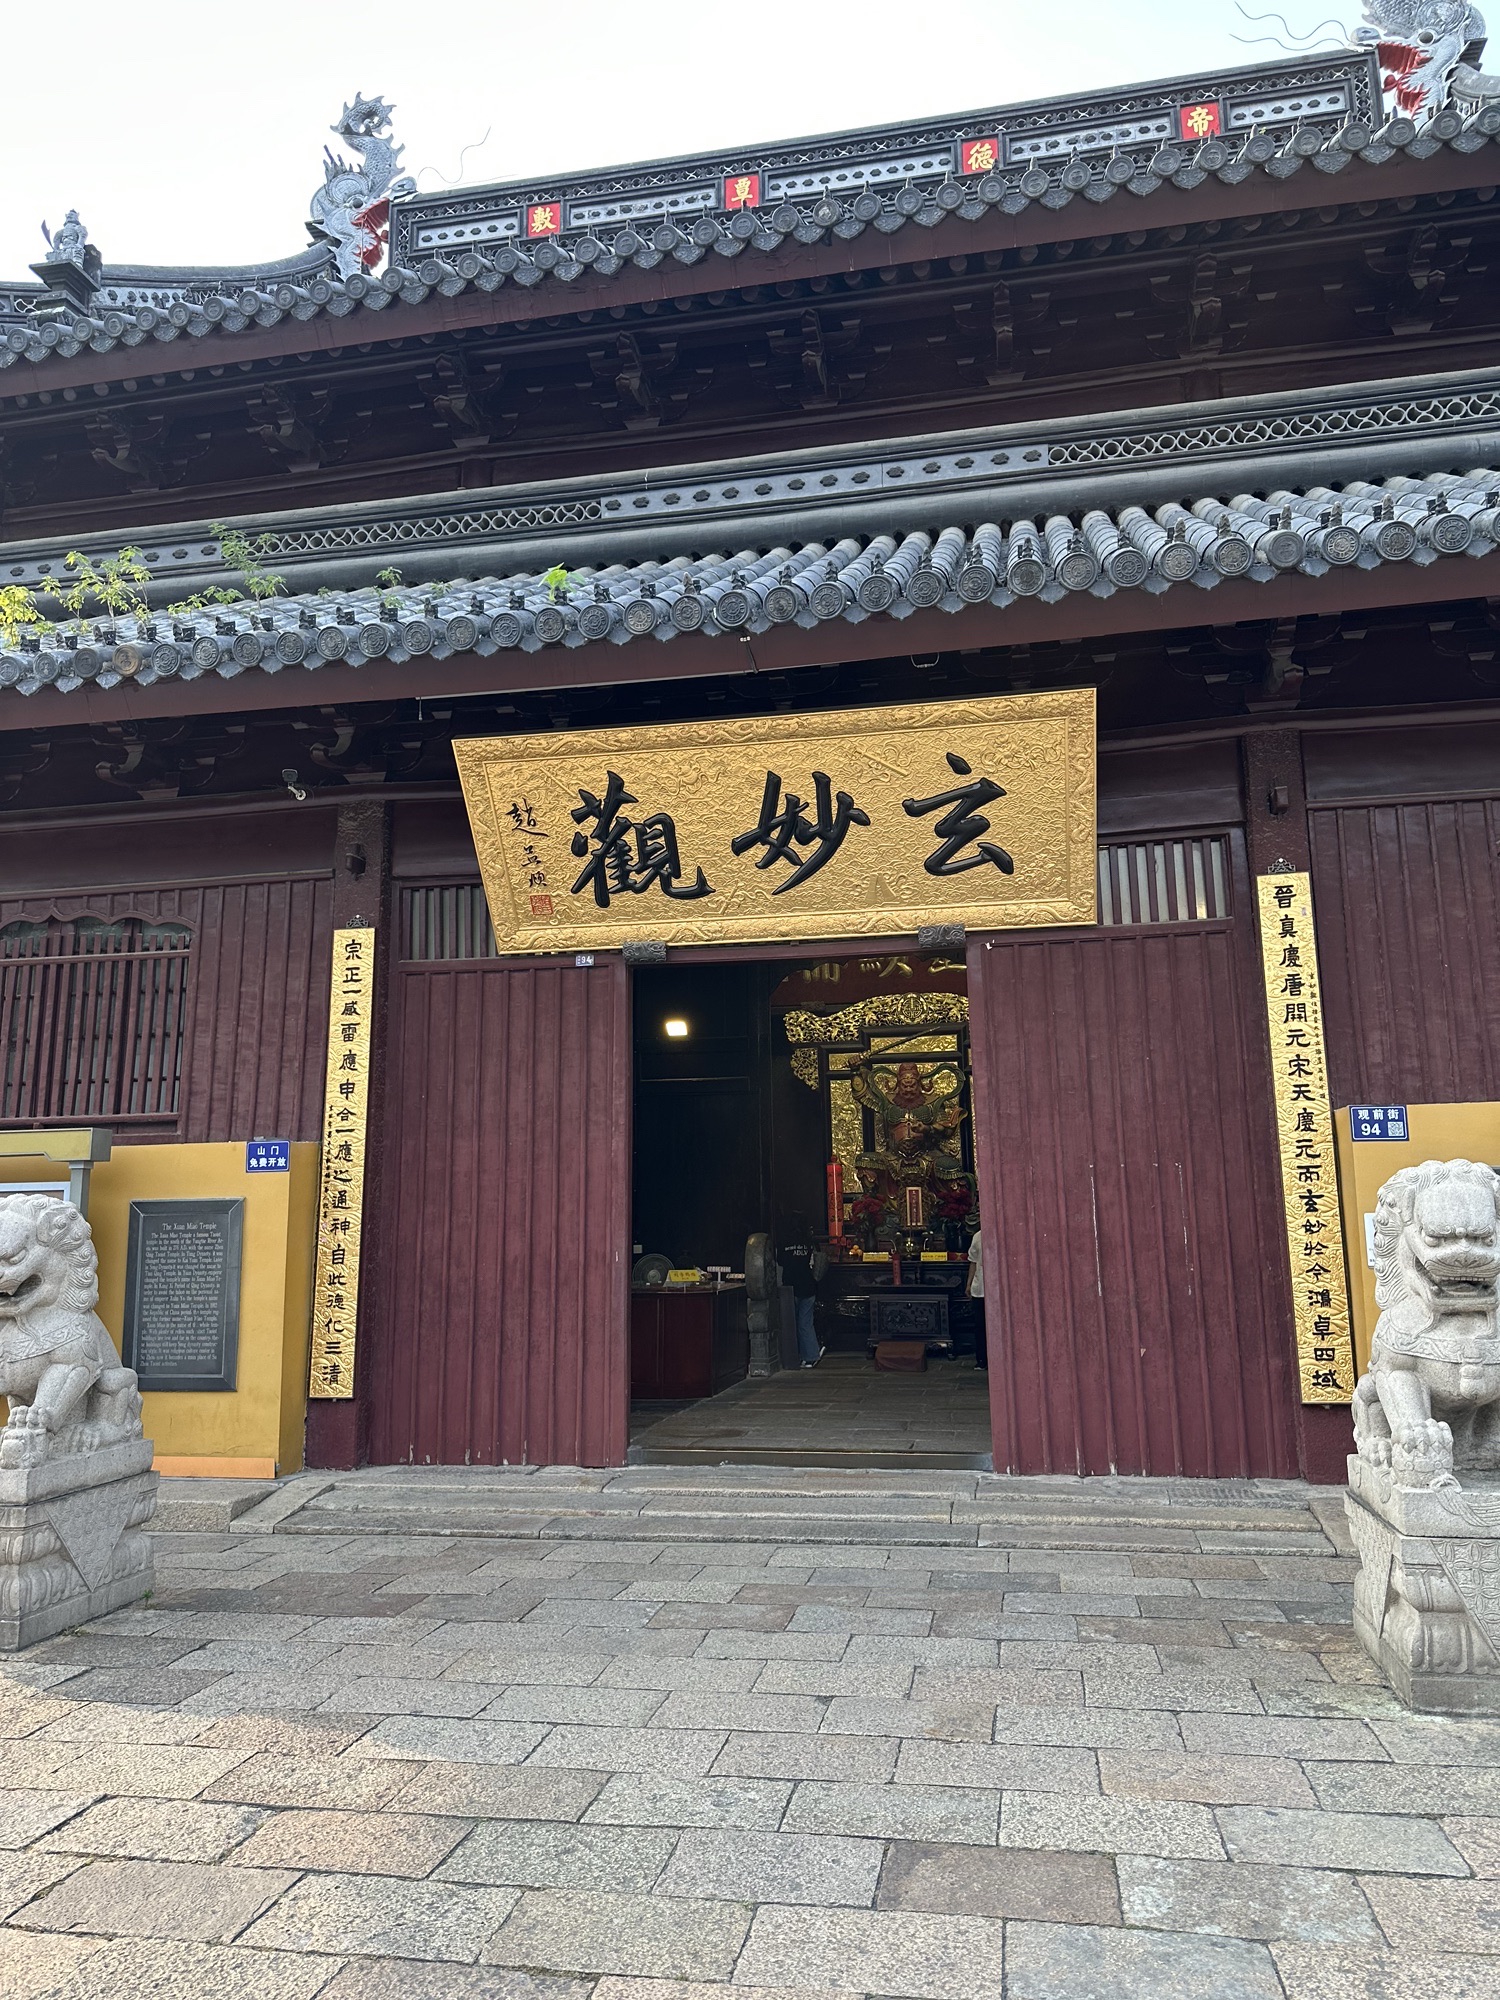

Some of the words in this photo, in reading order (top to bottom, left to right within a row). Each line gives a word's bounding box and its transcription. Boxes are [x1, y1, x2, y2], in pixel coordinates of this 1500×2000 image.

[1187, 106, 1214, 137] 帝
[967, 142, 995, 170] 德
[1358, 1109, 1399, 1120] 观前街
[1361, 1123, 1381, 1136] 94
[257, 1146, 279, 1155] 山门
[250, 1157, 286, 1168] 免费开放
